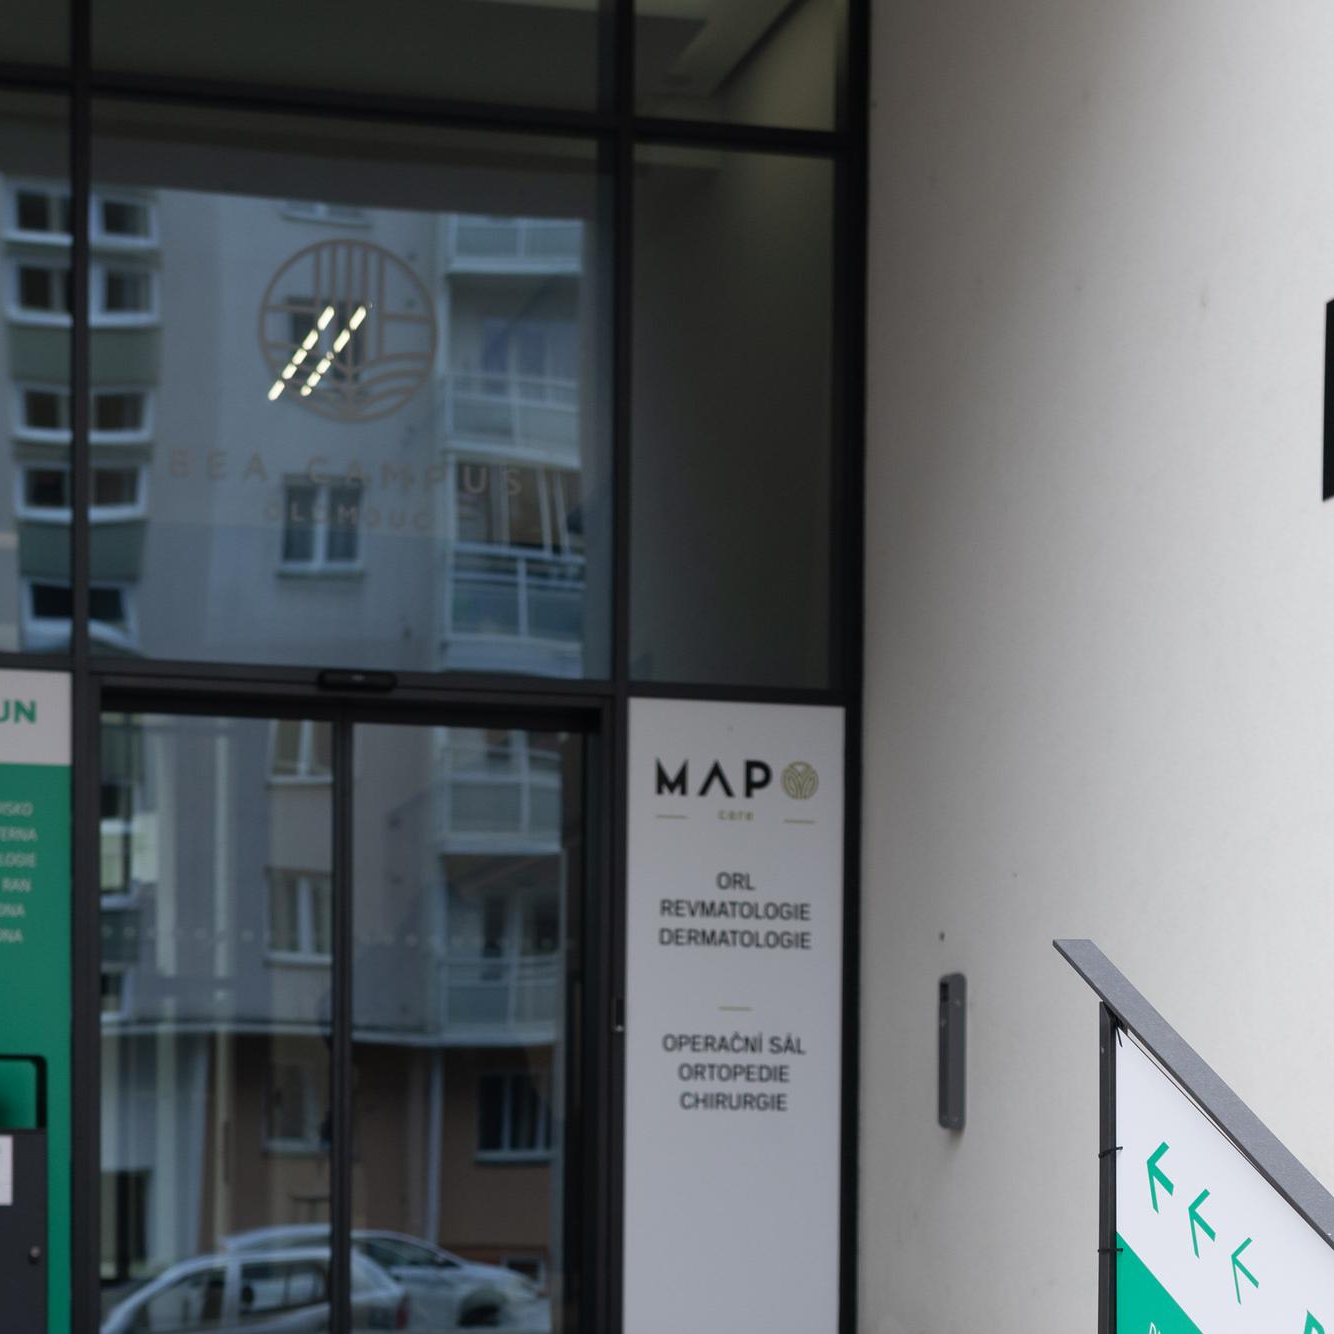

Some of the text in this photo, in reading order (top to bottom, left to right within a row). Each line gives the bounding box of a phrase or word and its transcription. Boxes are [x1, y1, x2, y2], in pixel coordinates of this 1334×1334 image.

[716, 872, 756, 891] ORL
[660, 899, 811, 921] REVMATOLOGIE
[659, 927, 812, 950] DERMATOLOGIE
[662, 1033, 806, 1055] OPERAČNÍ SÁL
[678, 1062, 790, 1083] ORTOPEDIE
[679, 1093, 787, 1112] CHIRURGIE
